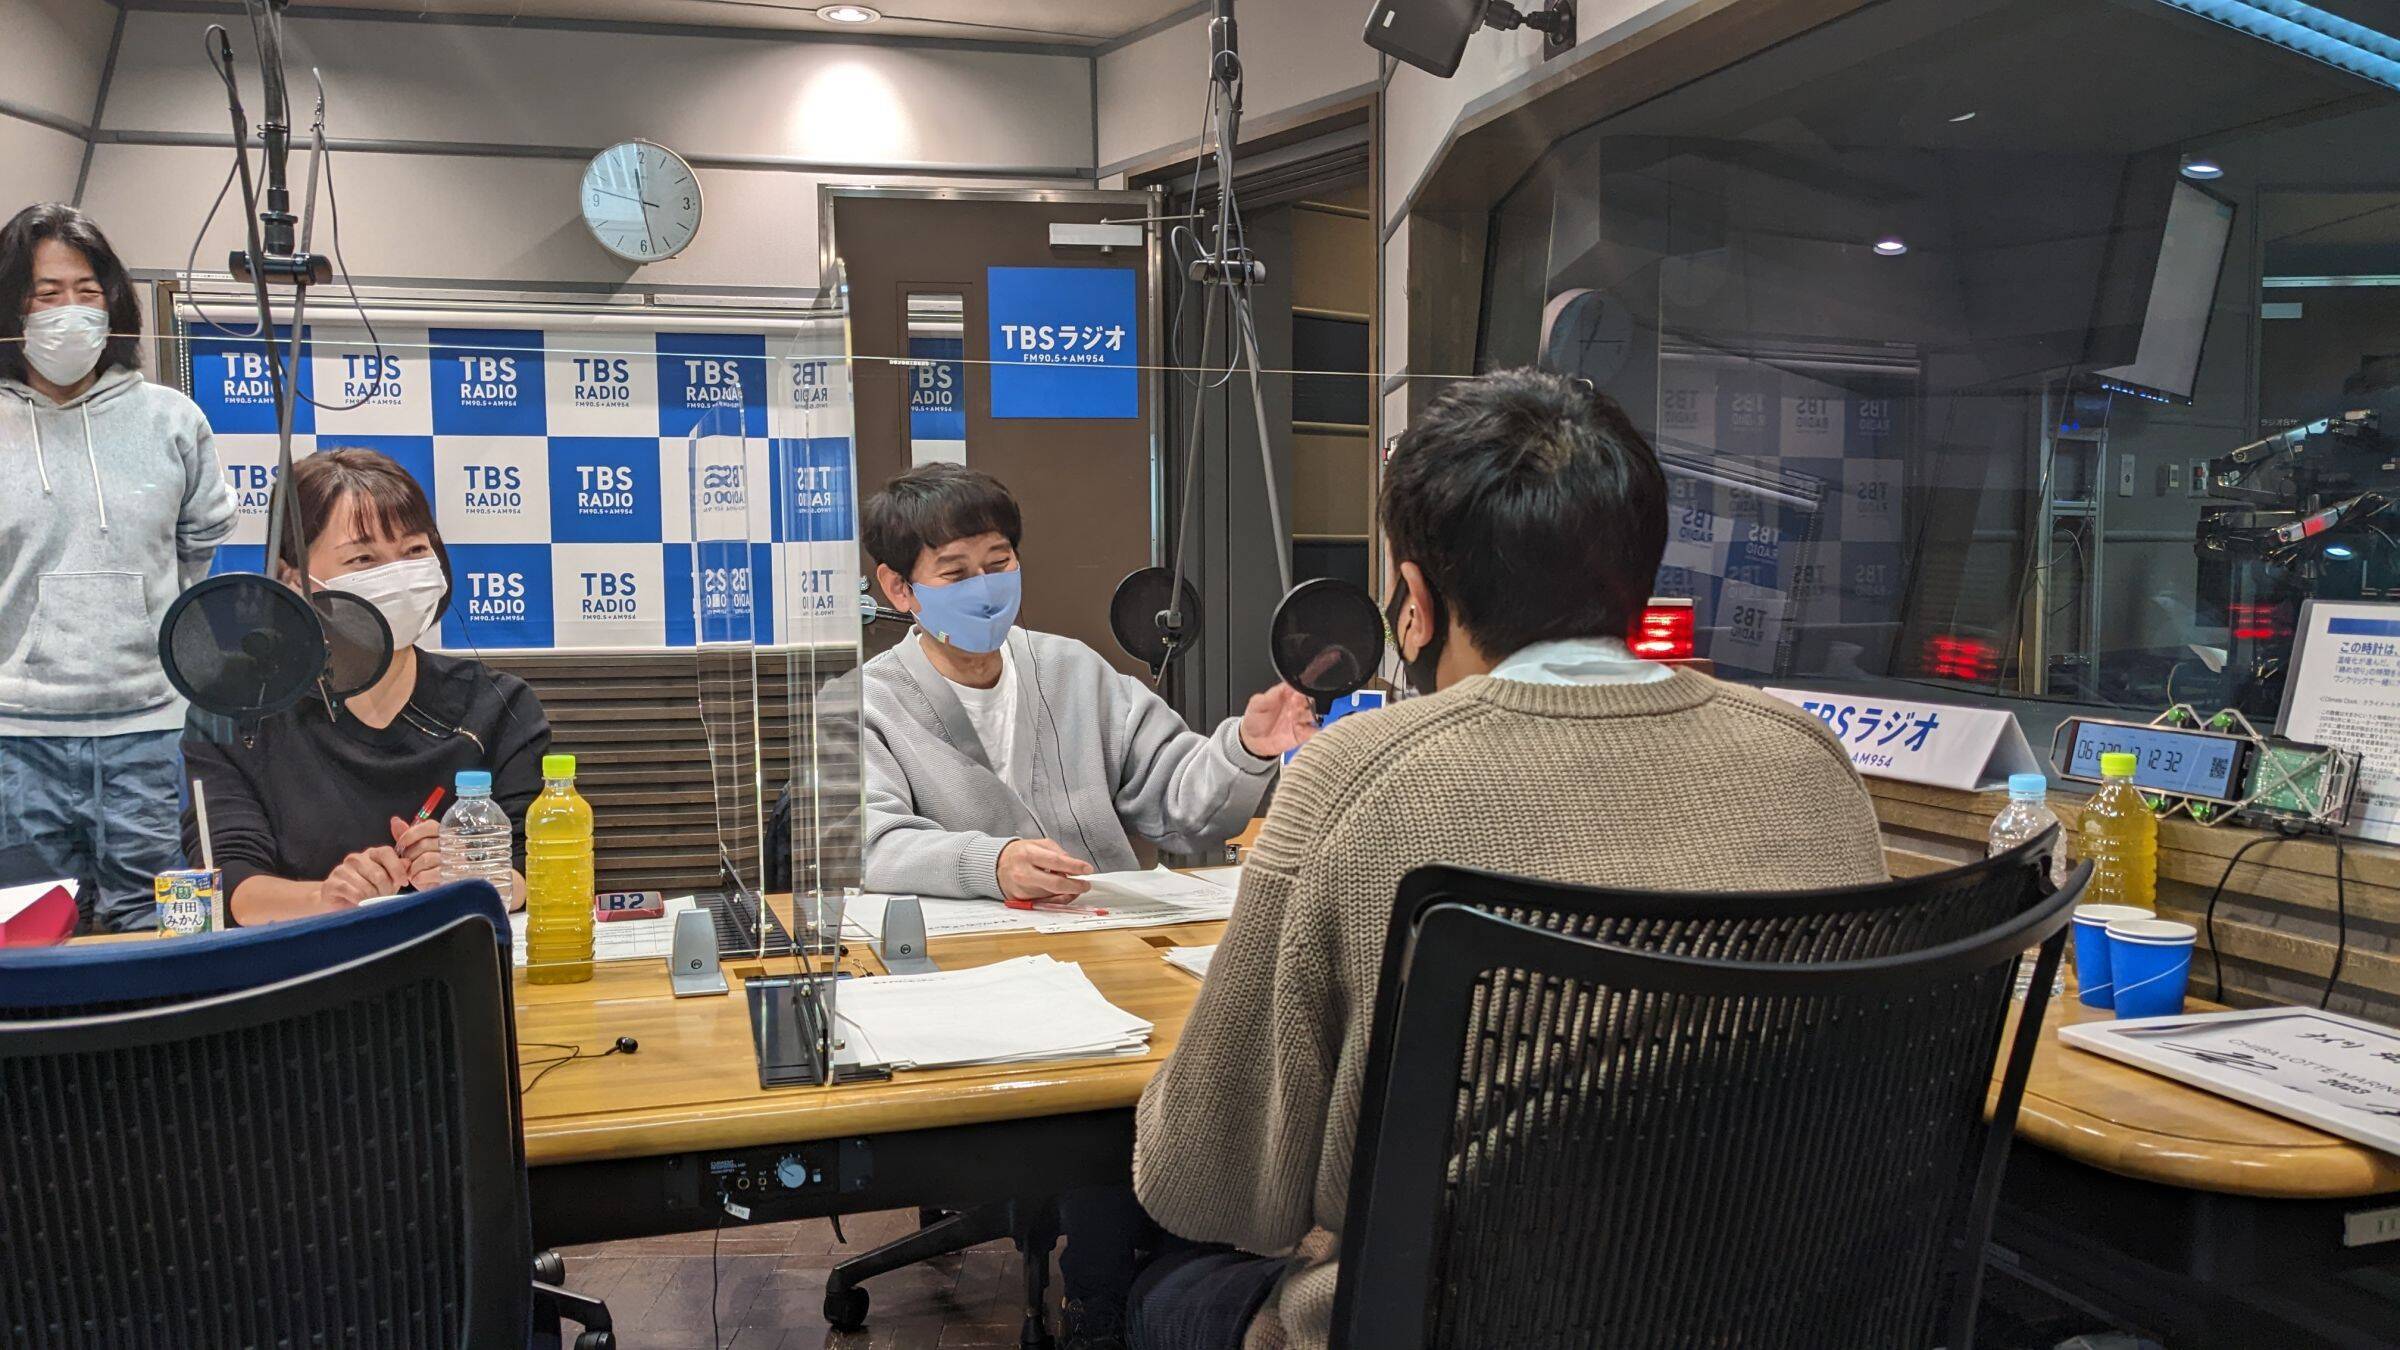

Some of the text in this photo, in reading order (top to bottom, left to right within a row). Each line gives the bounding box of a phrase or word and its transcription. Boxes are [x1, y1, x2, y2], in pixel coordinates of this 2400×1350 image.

[592, 193, 600, 208] 9
[682, 196, 691, 211] 3
[639, 239, 648, 253] 6
[1001, 325, 1126, 351] TBSラジオ
[342, 354, 401, 380] TBS
[458, 356, 517, 382] TBS
[573, 358, 629, 383] TBS
[684, 360, 740, 385] TBS
[345, 382, 402, 398] RADIO
[461, 384, 518, 399] RADIO
[575, 385, 630, 400] RADIO
[686, 387, 742, 401] RAD
[911, 390, 953, 405] ADIO
[224, 397, 276, 405] FM90.5+AM9
[463, 466, 521, 490] TBS
[576, 466, 633, 491] TBS
[465, 492, 521, 507] RADIO
[578, 493, 633, 507] RADIO
[467, 572, 525, 598] TBS
[581, 572, 636, 597] TBS
[469, 599, 525, 614] RADIO
[582, 599, 636, 613] RADIO
[2077, 739, 2094, 760] 06
[2164, 751, 2183, 773] 32
[171, 901, 197, 914] 有田
[165, 914, 203, 927] みかん
[2278, 1054, 2340, 1074] LOTTE
